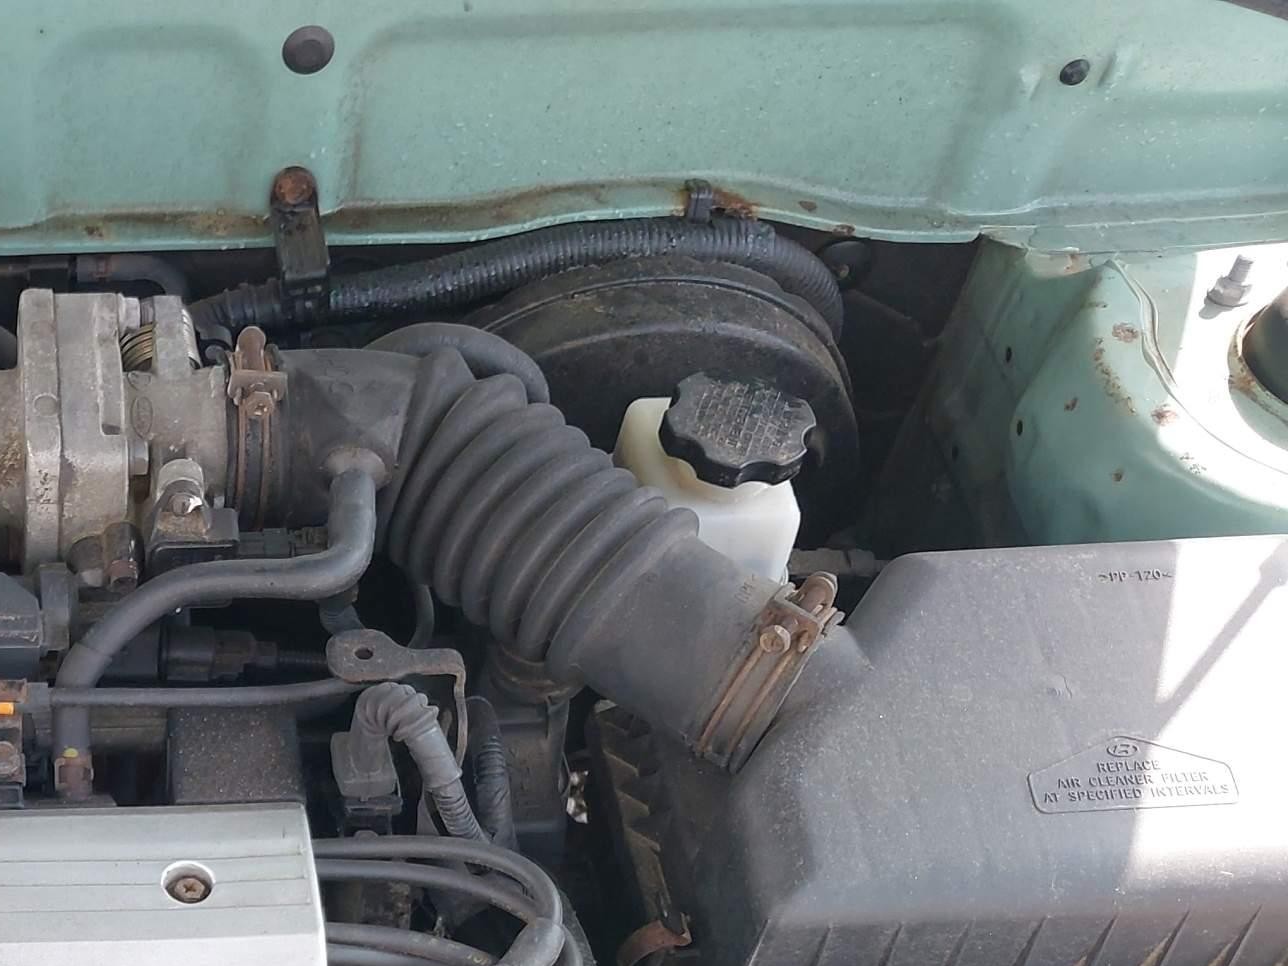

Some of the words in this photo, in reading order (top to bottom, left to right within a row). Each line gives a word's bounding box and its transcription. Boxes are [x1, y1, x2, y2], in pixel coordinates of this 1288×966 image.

[1095, 759, 1161, 774] REPLACE
[1056, 776, 1081, 790] AIR
[1087, 773, 1153, 788] CLEANER
[1161, 771, 1209, 784] FILTER
[1043, 791, 1061, 804] AT
[1067, 787, 1142, 803] SPECIFIED
[1150, 783, 1231, 798] INTERVALS
